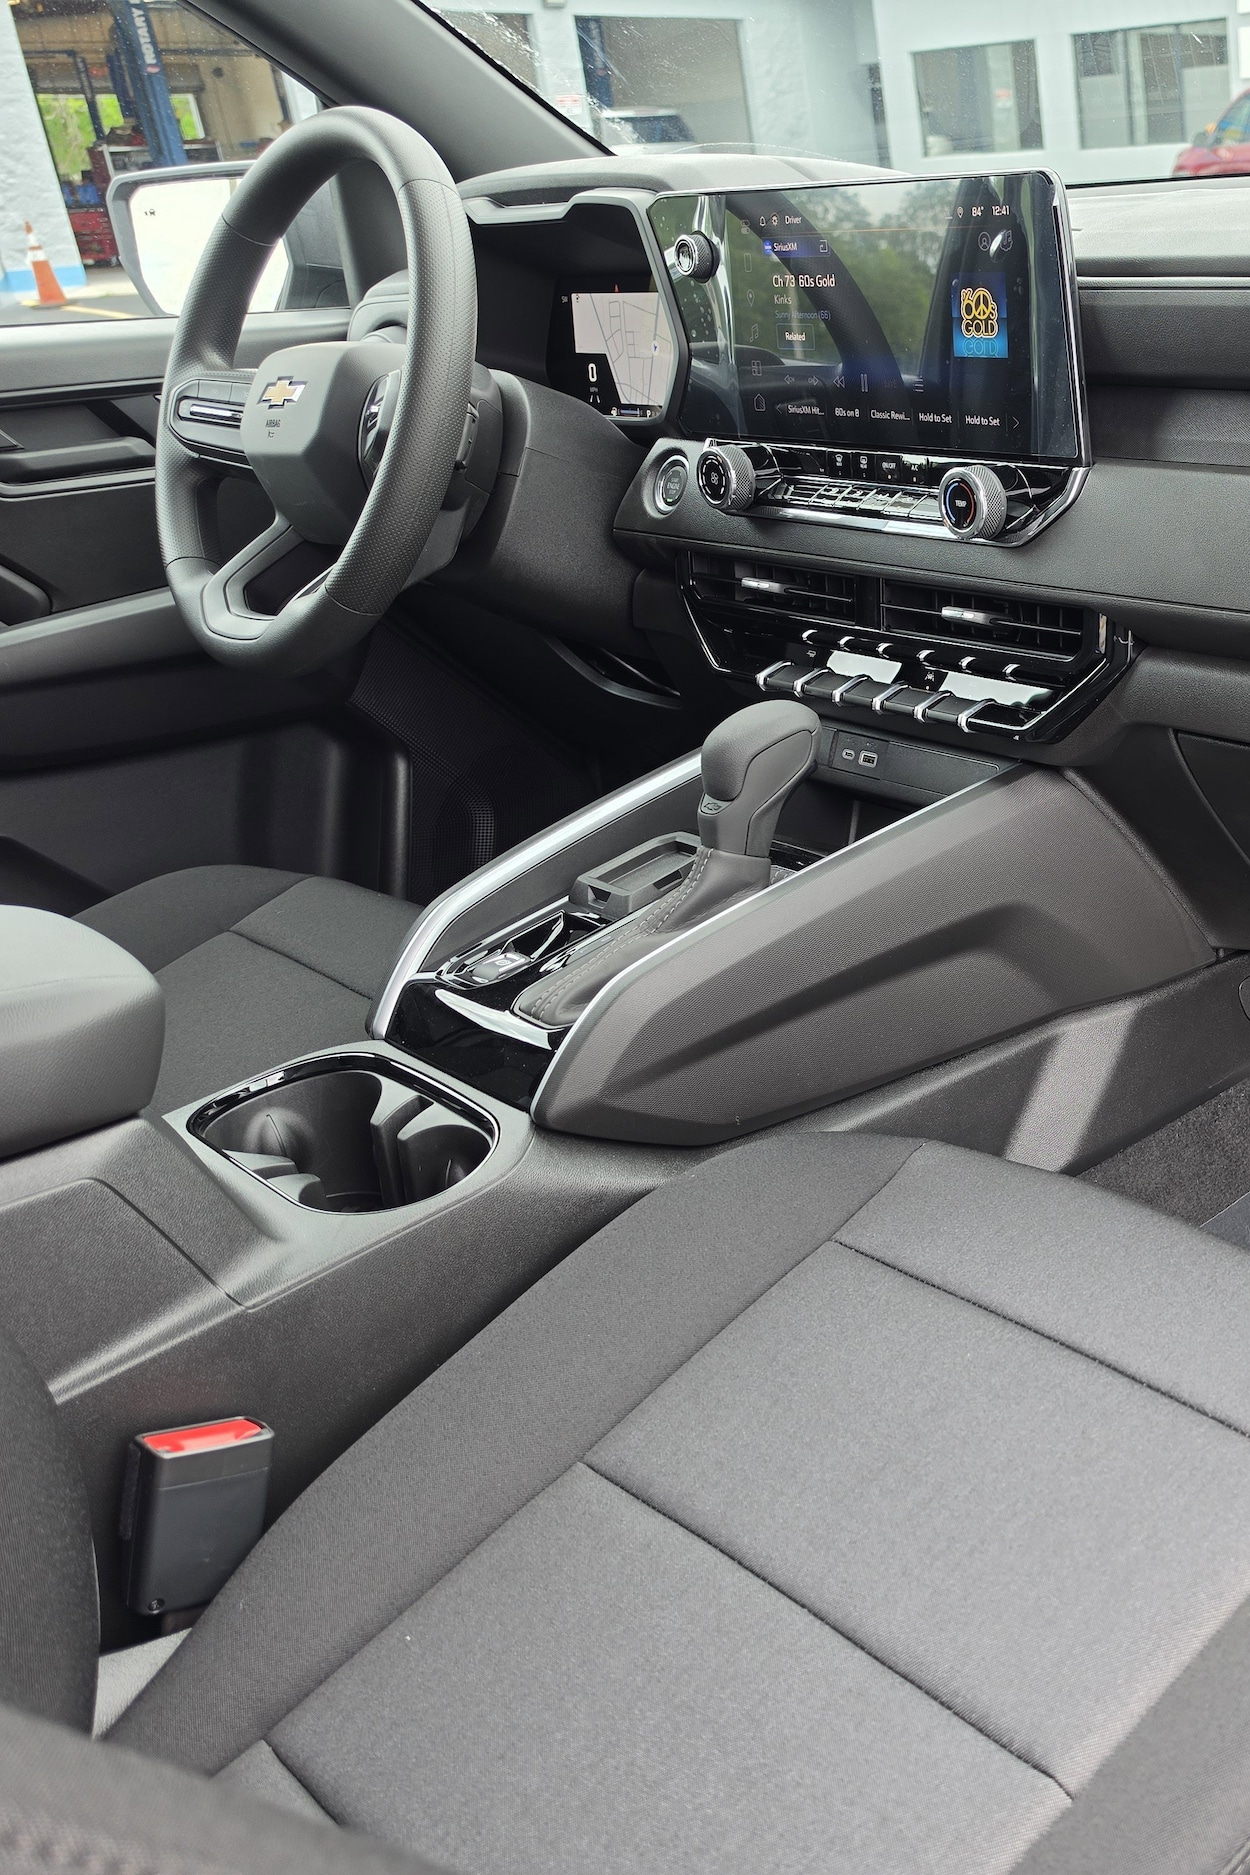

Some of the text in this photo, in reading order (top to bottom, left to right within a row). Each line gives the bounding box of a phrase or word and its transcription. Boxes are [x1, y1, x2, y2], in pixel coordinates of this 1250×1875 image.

[130, 7, 157, 64] ROTARY
[991, 205, 1010, 216] 12:41
[785, 215, 802, 225] Driver
[773, 242, 798, 252] SiriusXM
[772, 273, 836, 288] Ch 73 60s Gold
[774, 294, 792, 305] Kinks
[962, 320, 998, 337] GOLD
[785, 332, 806, 341] Related
[588, 363, 597, 382] 0
[787, 404, 811, 415] SiriusXM
[847, 409, 855, 417] on
[871, 410, 890, 420] Classic
[918, 412, 953, 424] Hold to Set
[965, 415, 1000, 427] Hold to Set
